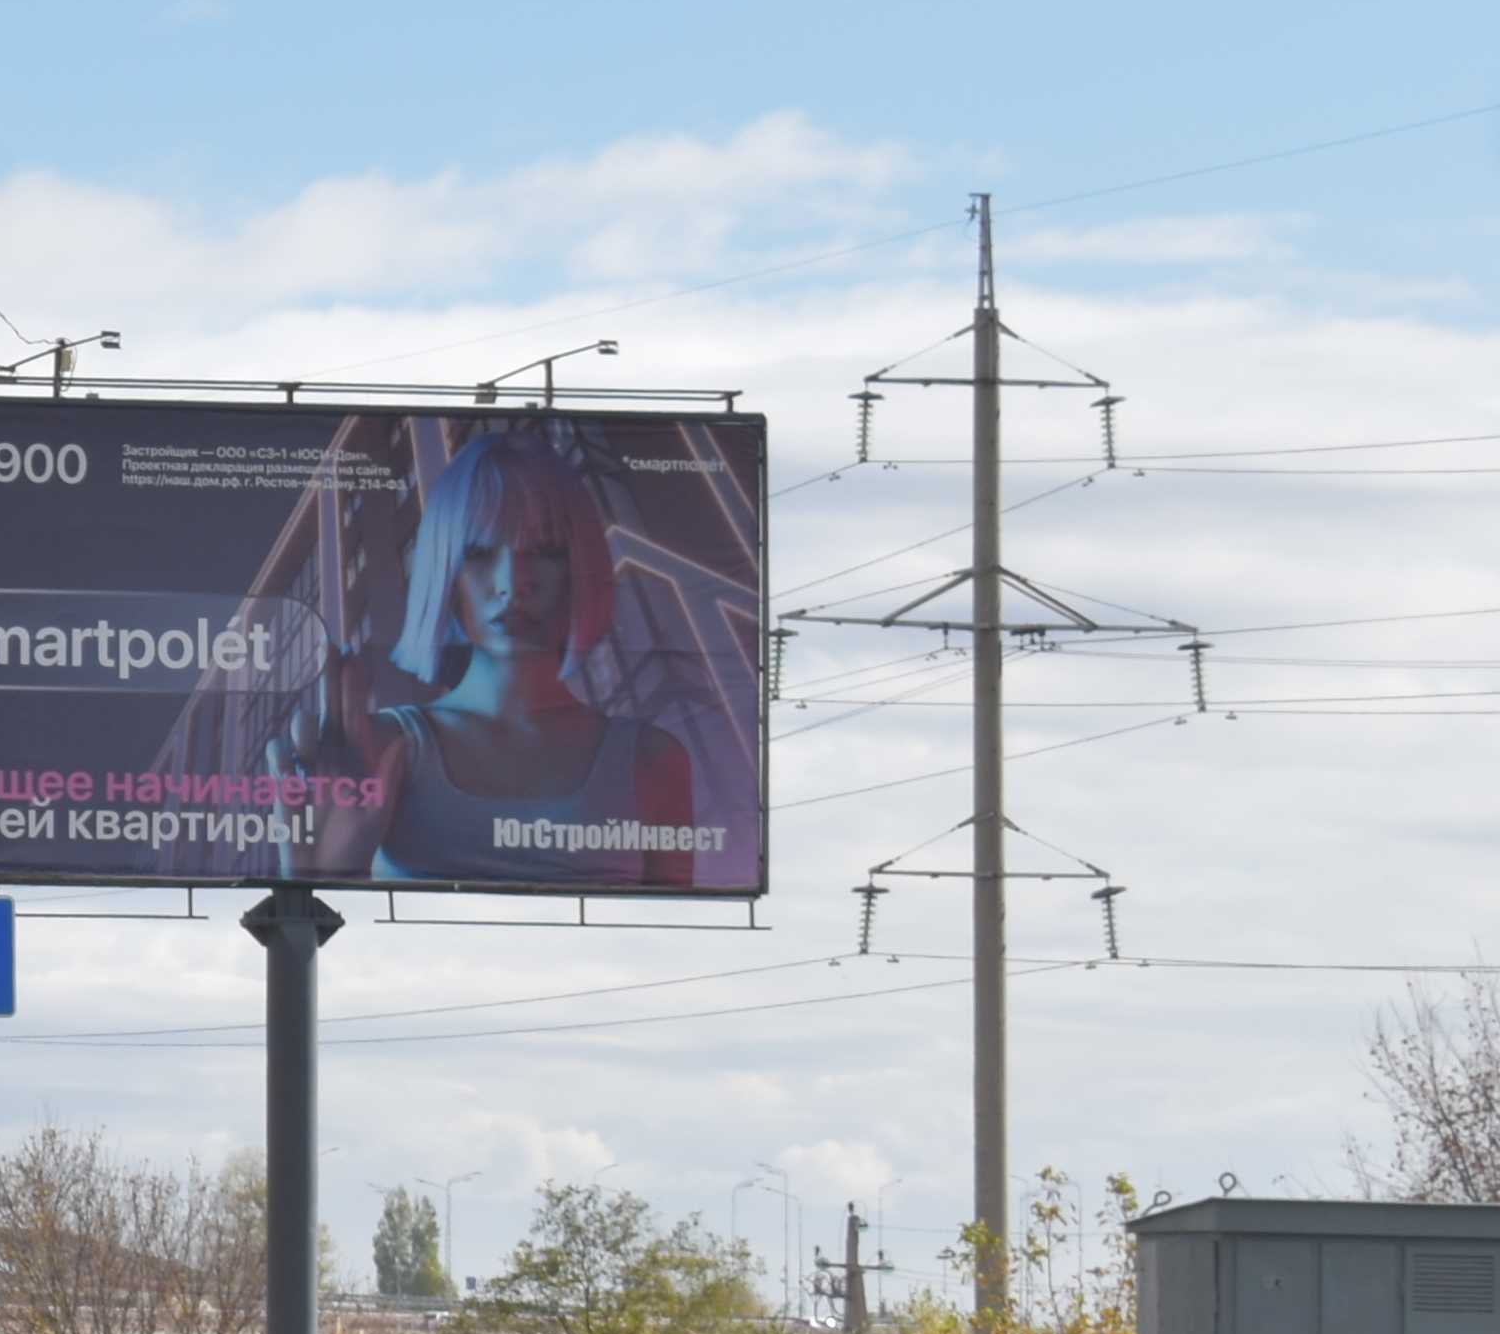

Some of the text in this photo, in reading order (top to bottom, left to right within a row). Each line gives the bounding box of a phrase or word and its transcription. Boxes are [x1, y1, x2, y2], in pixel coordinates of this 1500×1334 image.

[122, 444, 199, 458] Застройщик
[216, 446, 247, 460] ООО
[355, 464, 392, 476] сайте
[106, 770, 385, 809] начинается
[68, 805, 315, 852] квартиры!
[493, 818, 727, 852] ЮгСтройИнвест
